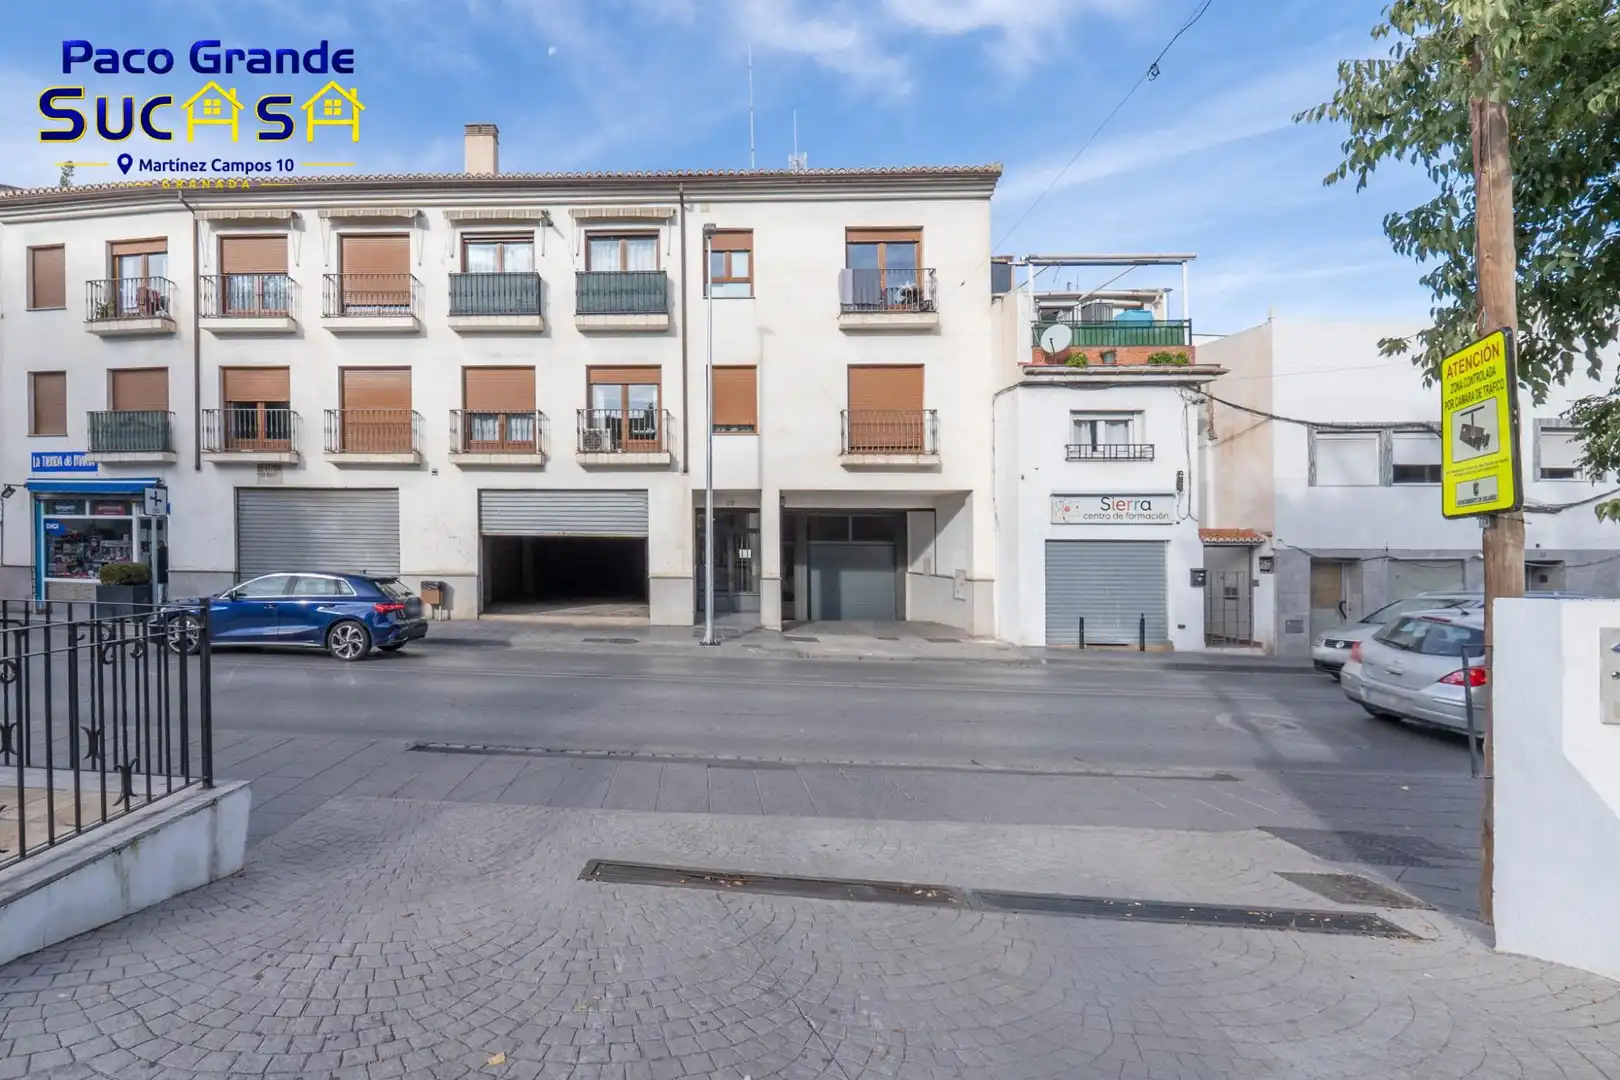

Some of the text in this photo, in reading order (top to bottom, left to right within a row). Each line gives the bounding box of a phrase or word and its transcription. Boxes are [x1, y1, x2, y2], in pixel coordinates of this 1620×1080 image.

[1446, 341, 1500, 379] ATENCIÓN
[1450, 366, 1496, 394] ZONA CONTROLADA
[1444, 398, 1454, 412] POR
[1475, 387, 1482, 400] DE
[1082, 511, 1170, 521] centro de formación
[1100, 496, 1152, 512] Sierra
